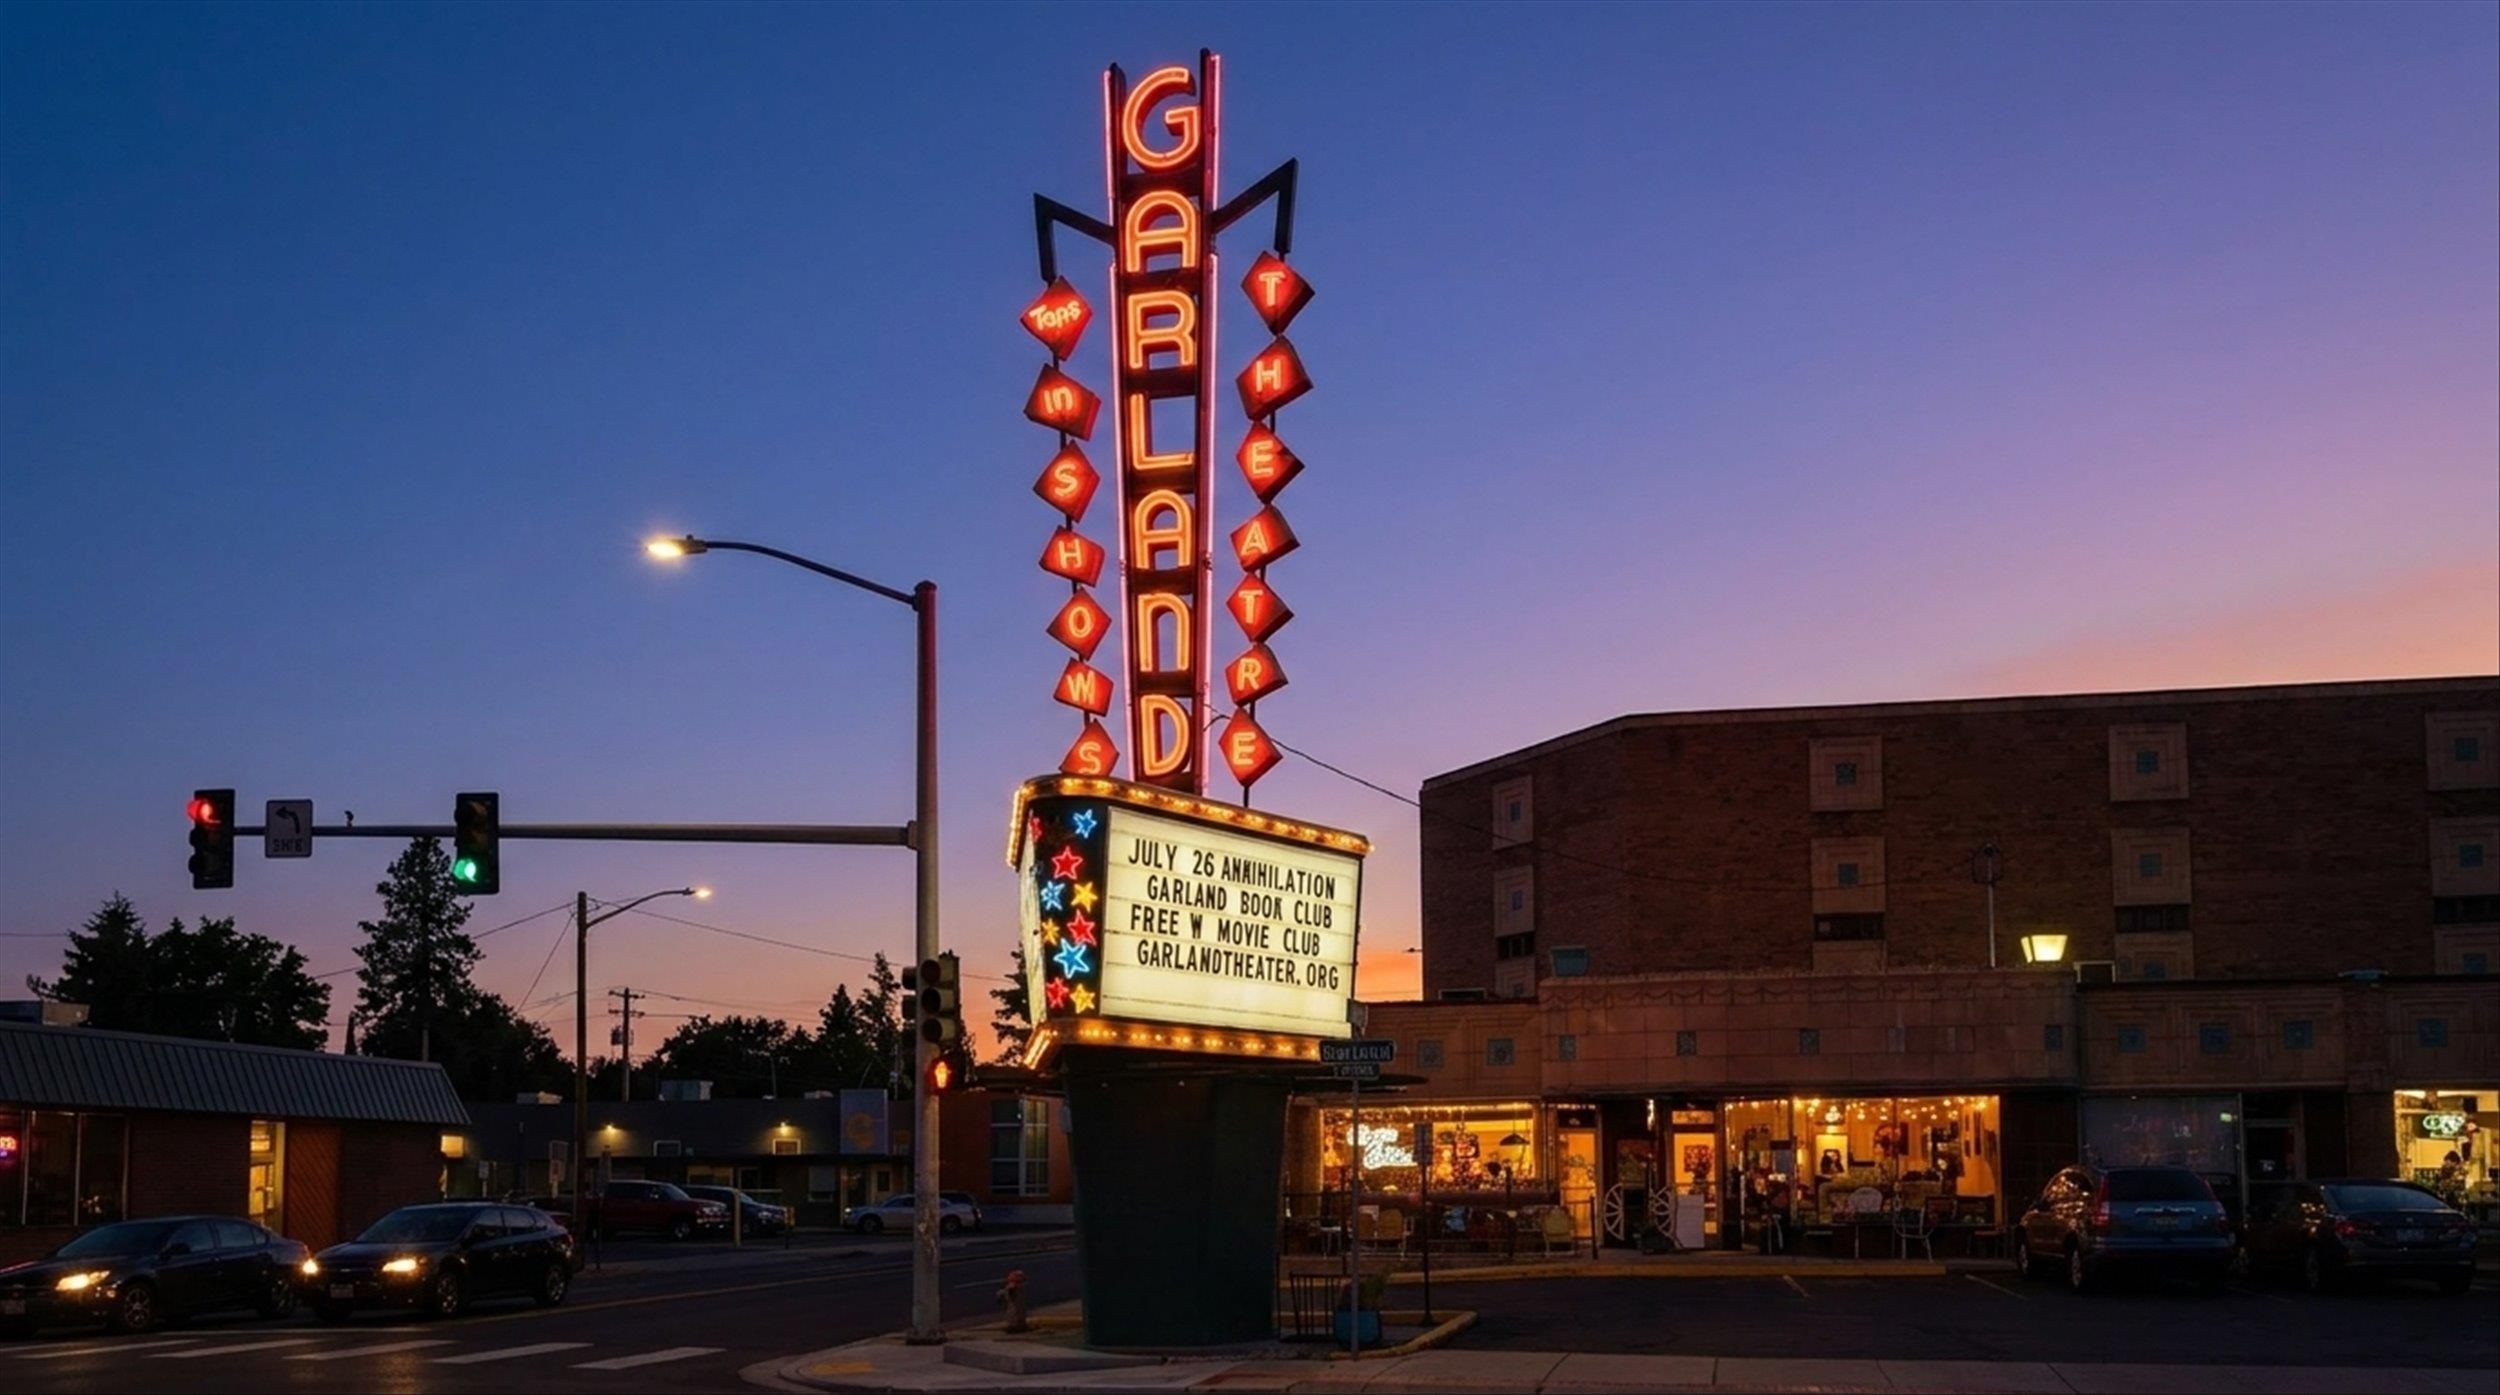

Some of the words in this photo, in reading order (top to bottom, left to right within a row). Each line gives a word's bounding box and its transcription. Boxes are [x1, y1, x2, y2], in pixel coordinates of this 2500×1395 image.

[1122, 66, 1199, 777] GARLAND
[1232, 271, 1285, 765] THEATRE
[1054, 463, 1101, 774] SHOWS
[1128, 838, 1177, 871] JULY
[1193, 849, 1214, 877] 26
[1130, 904, 1179, 936] FREE
[1190, 913, 1203, 939] W
[1217, 918, 1269, 949] MOVIE
[1283, 927, 1320, 956] CLUB
[1147, 874, 1227, 911] GARLAND
[1240, 891, 1283, 921] BOOK
[1294, 900, 1332, 928] CLUB
